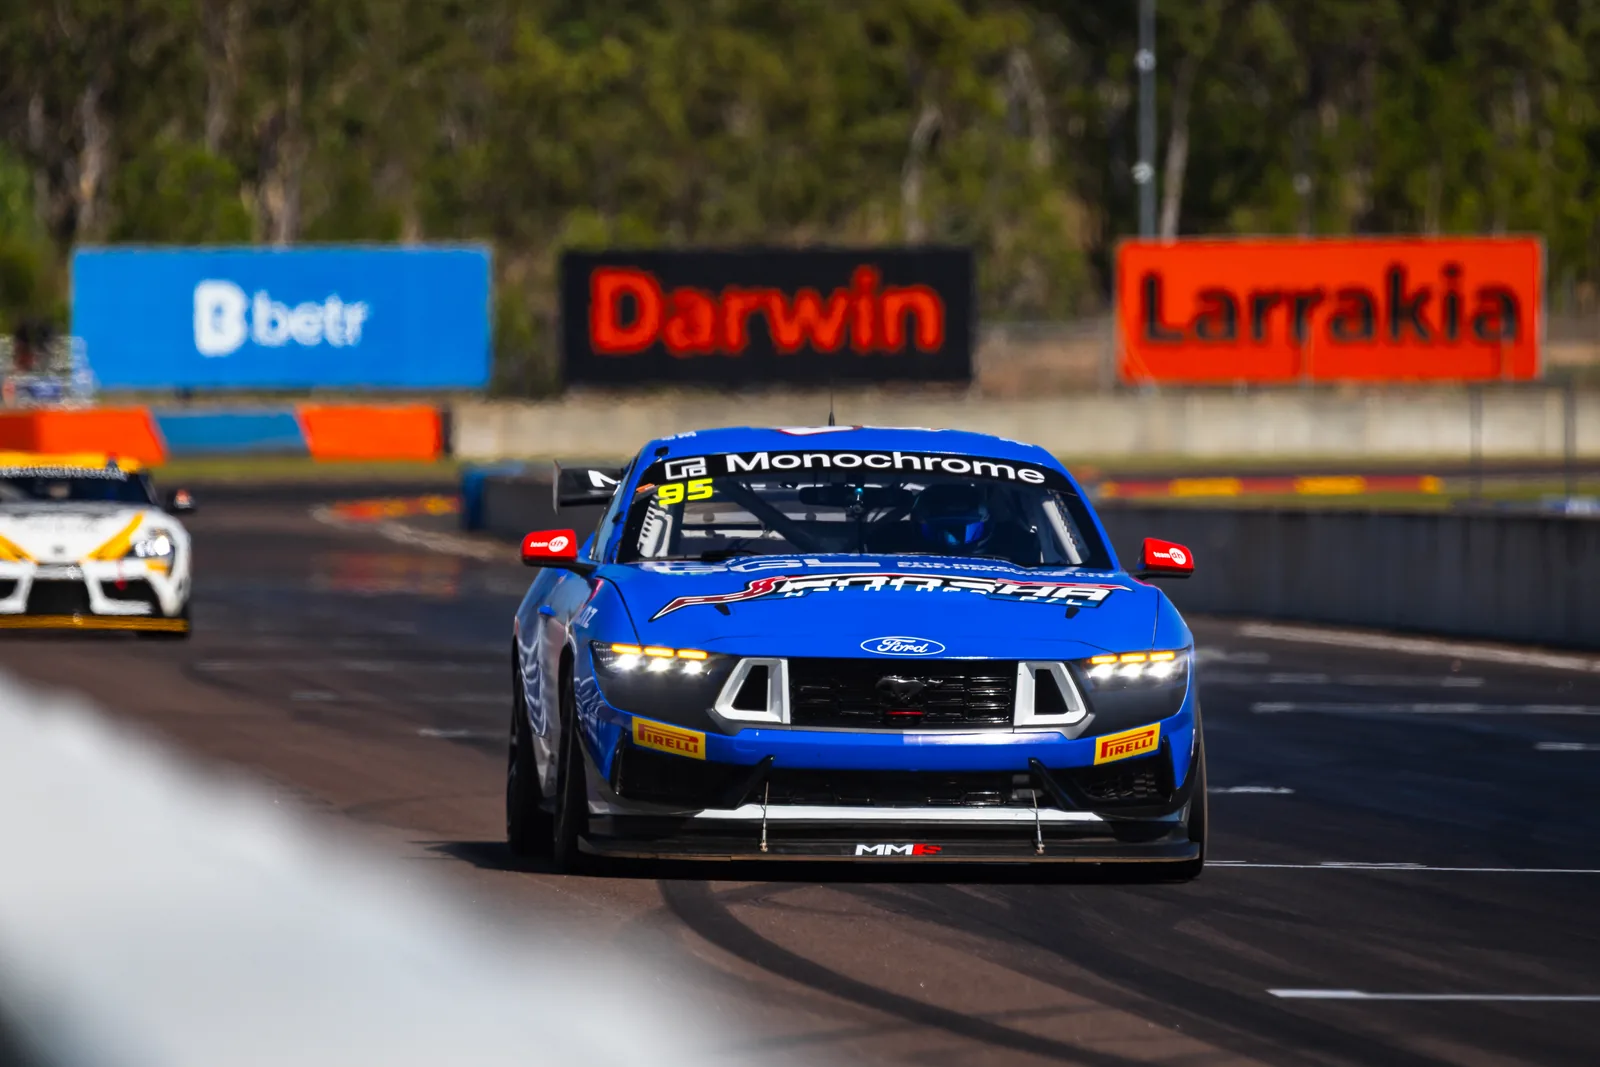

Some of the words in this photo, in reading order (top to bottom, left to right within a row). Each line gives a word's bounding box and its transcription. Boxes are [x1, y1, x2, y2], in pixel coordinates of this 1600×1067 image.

[251, 289, 368, 347] betr
[590, 265, 945, 356] Darwin
[1141, 262, 1520, 343] Larrakia
[725, 451, 1046, 484] Monochrome
[657, 478, 713, 506] 95
[876, 638, 930, 653] Ford
[637, 723, 699, 754] PIRELLI
[1100, 729, 1155, 759] PIRELLI
